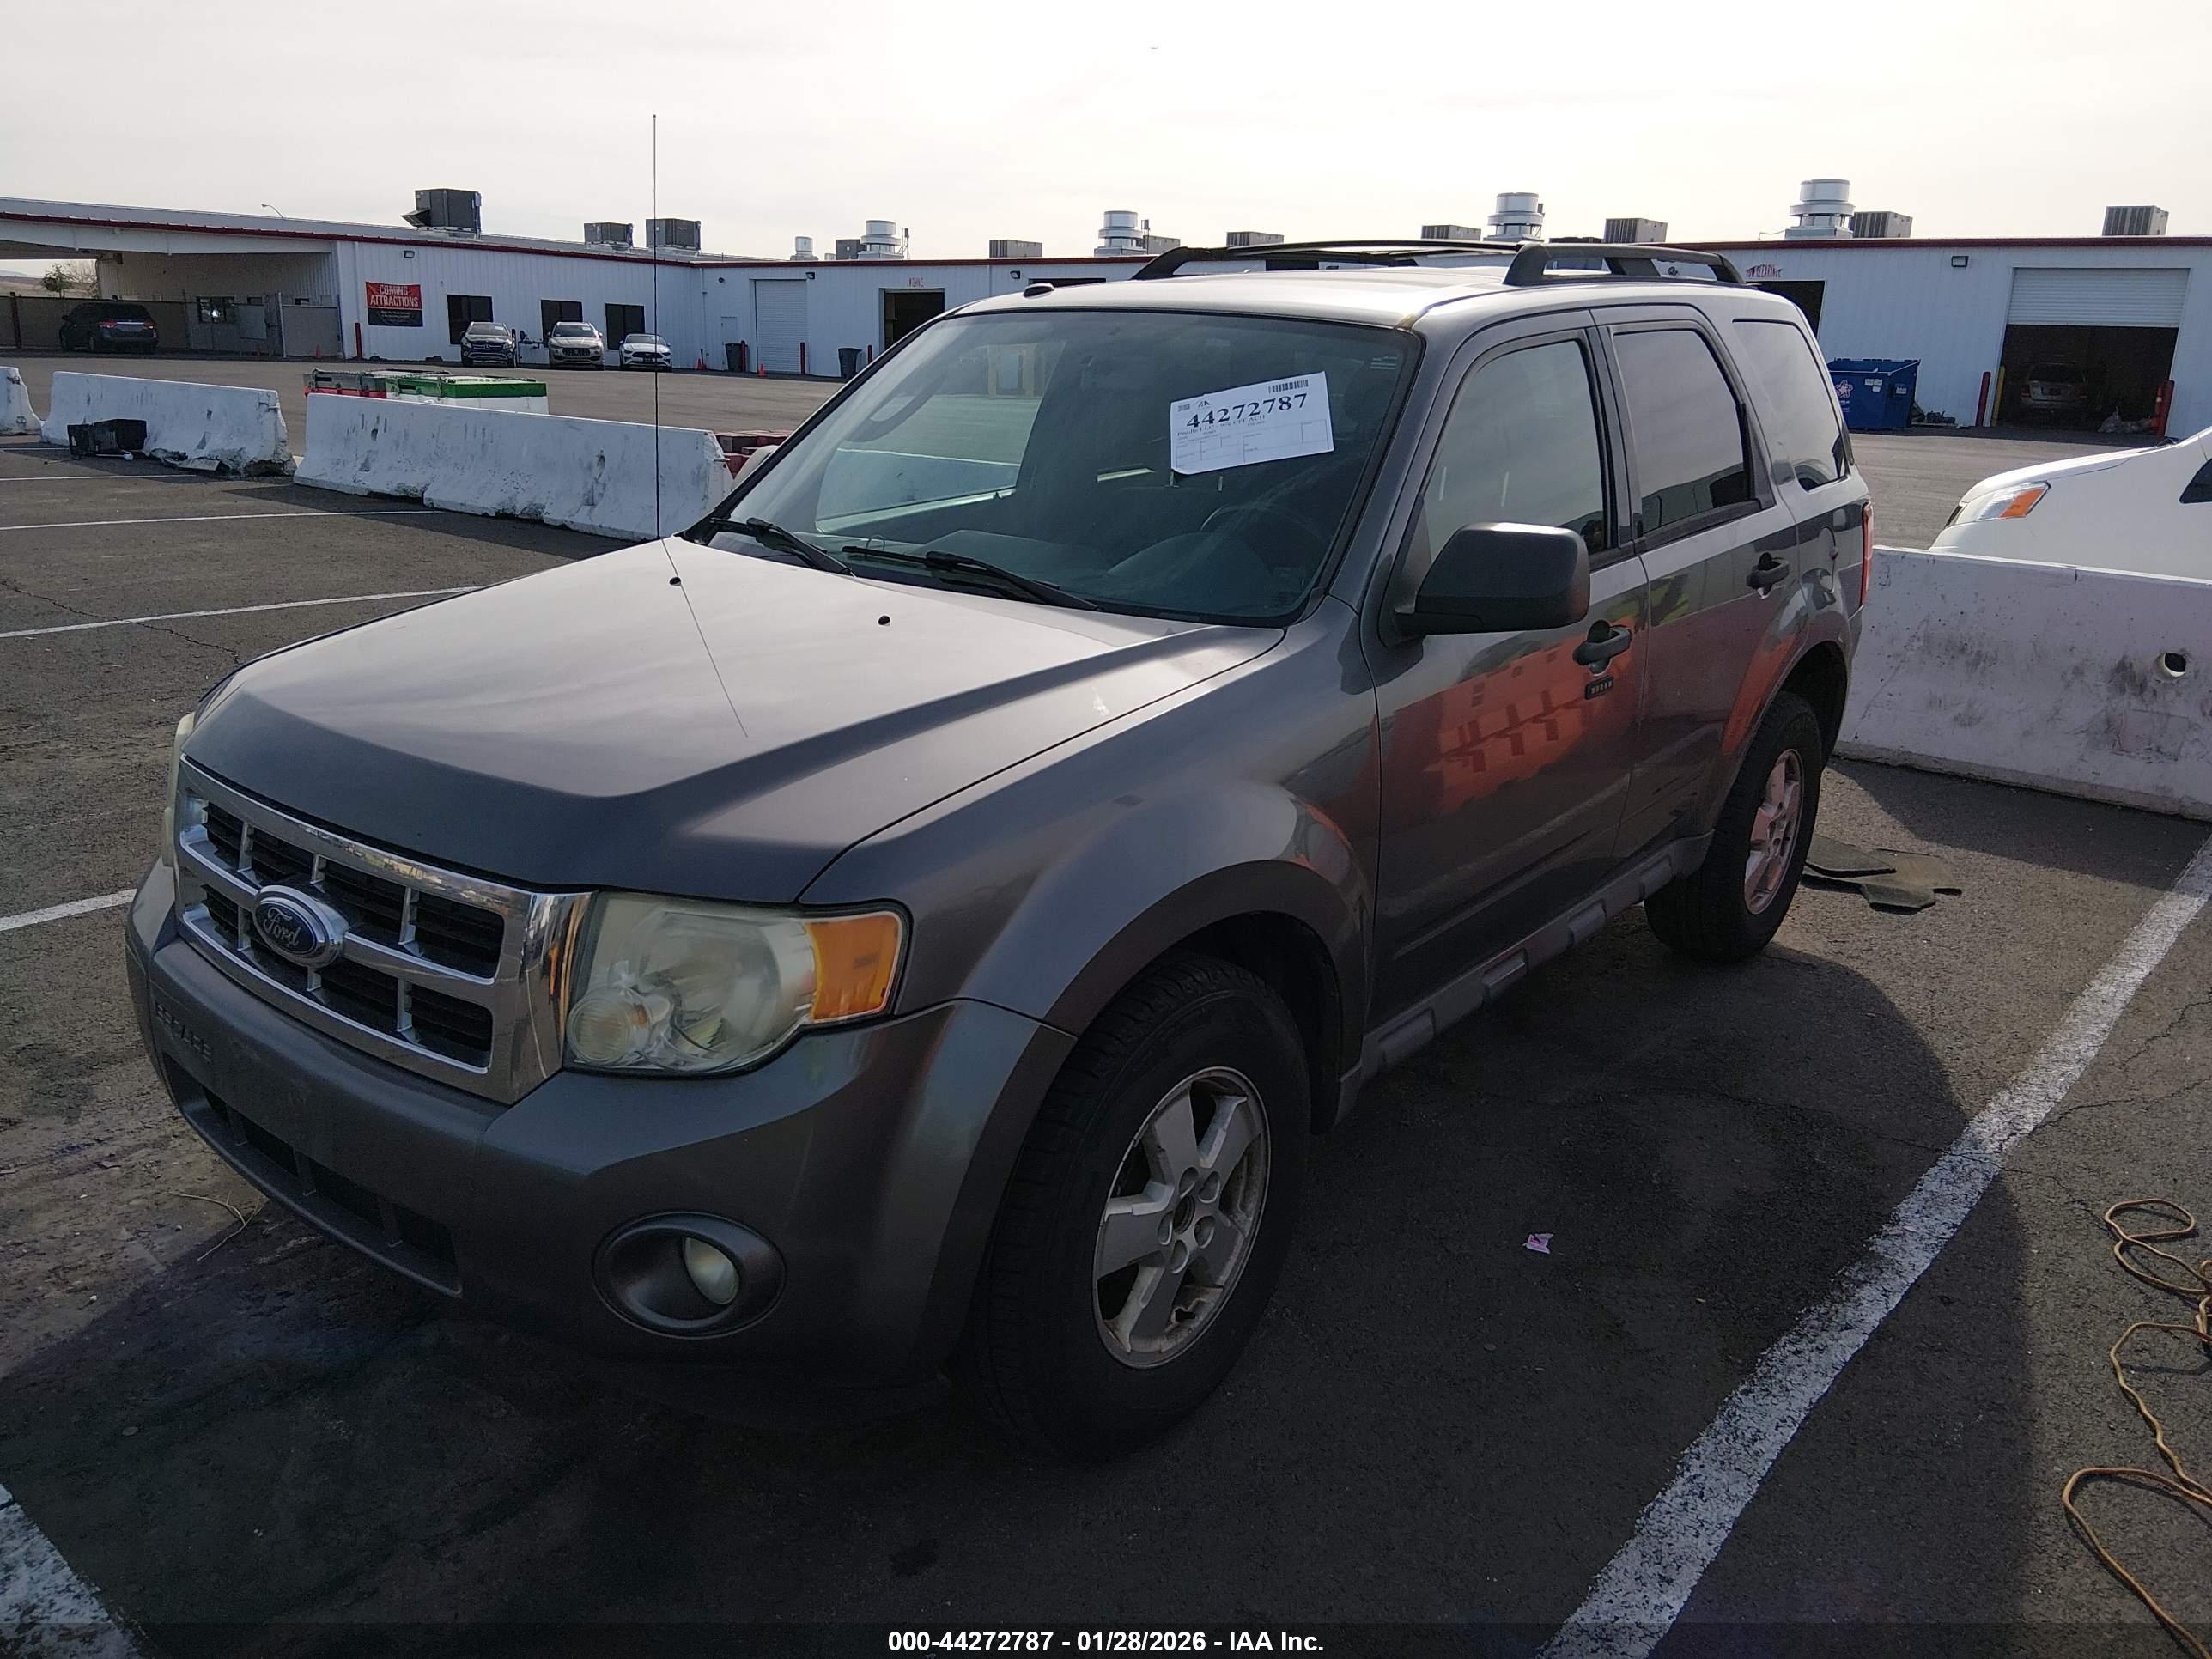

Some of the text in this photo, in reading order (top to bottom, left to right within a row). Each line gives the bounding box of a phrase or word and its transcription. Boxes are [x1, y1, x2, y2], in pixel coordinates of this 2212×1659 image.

[370, 295, 419, 307] ATTRACTIONS
[379, 284, 409, 296] COMING
[1186, 393, 1308, 428] 44272787
[263, 907, 301, 948] Ford
